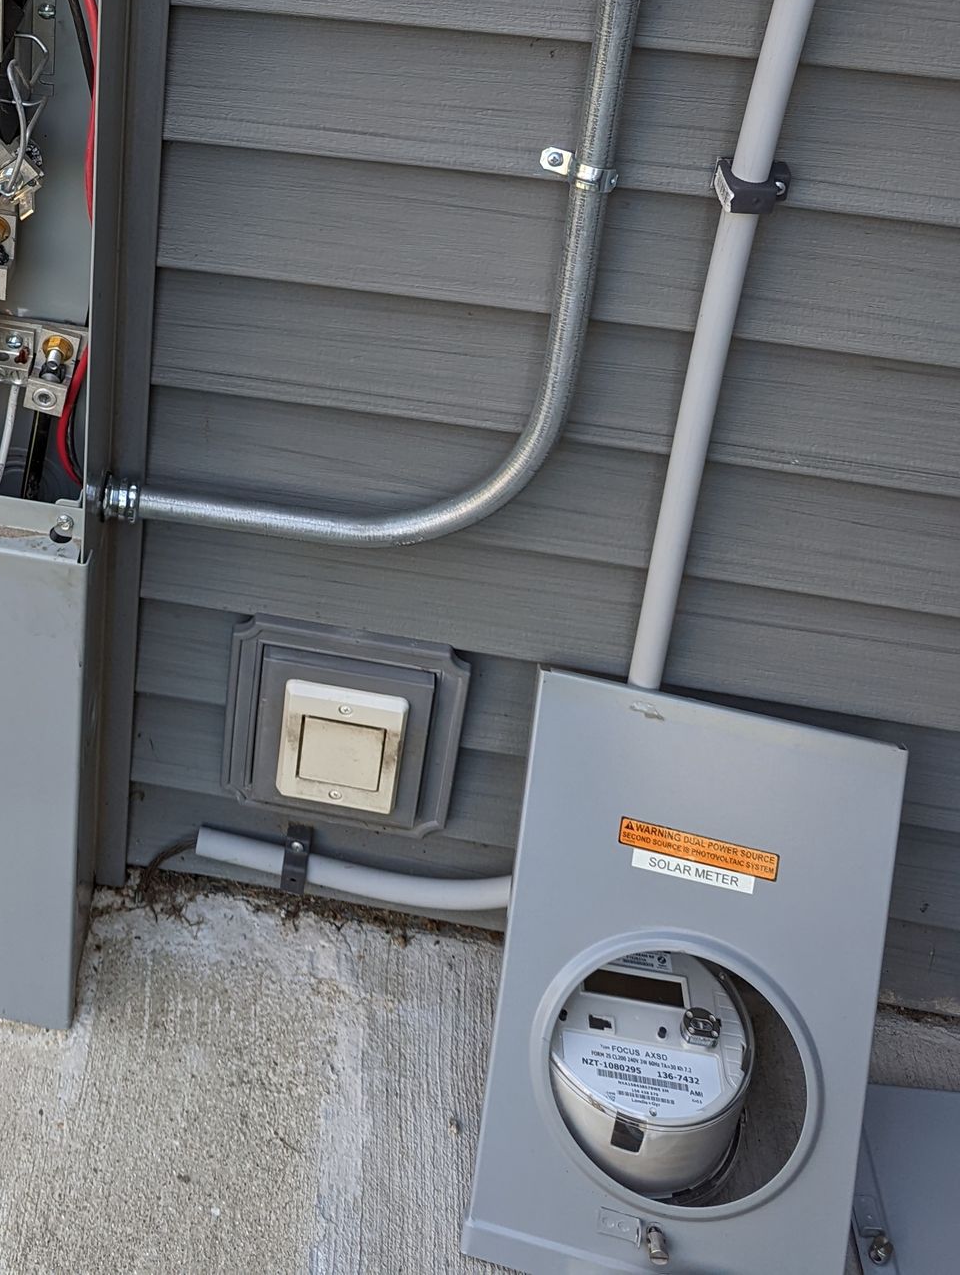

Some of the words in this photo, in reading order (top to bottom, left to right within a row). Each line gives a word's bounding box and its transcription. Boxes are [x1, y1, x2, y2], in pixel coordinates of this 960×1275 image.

[623, 831, 651, 844] SECOND
[652, 837, 681, 851] SOURCE
[692, 849, 745, 867] PHOTOVOLTAIC
[746, 862, 774, 874] SYSTEM
[635, 823, 681, 842] WARNING
[683, 836, 705, 847] DUAL
[708, 842, 738, 855] POWER
[741, 850, 775, 865] SOURCE
[649, 857, 692, 875] SOLAR
[695, 867, 739, 887] METER
[612, 1045, 640, 1056] FOCUS
[645, 1051, 667, 1061] AXSD
[582, 1057, 641, 1074] NZT-1080295
[657, 1071, 699, 1084] 136-7432
